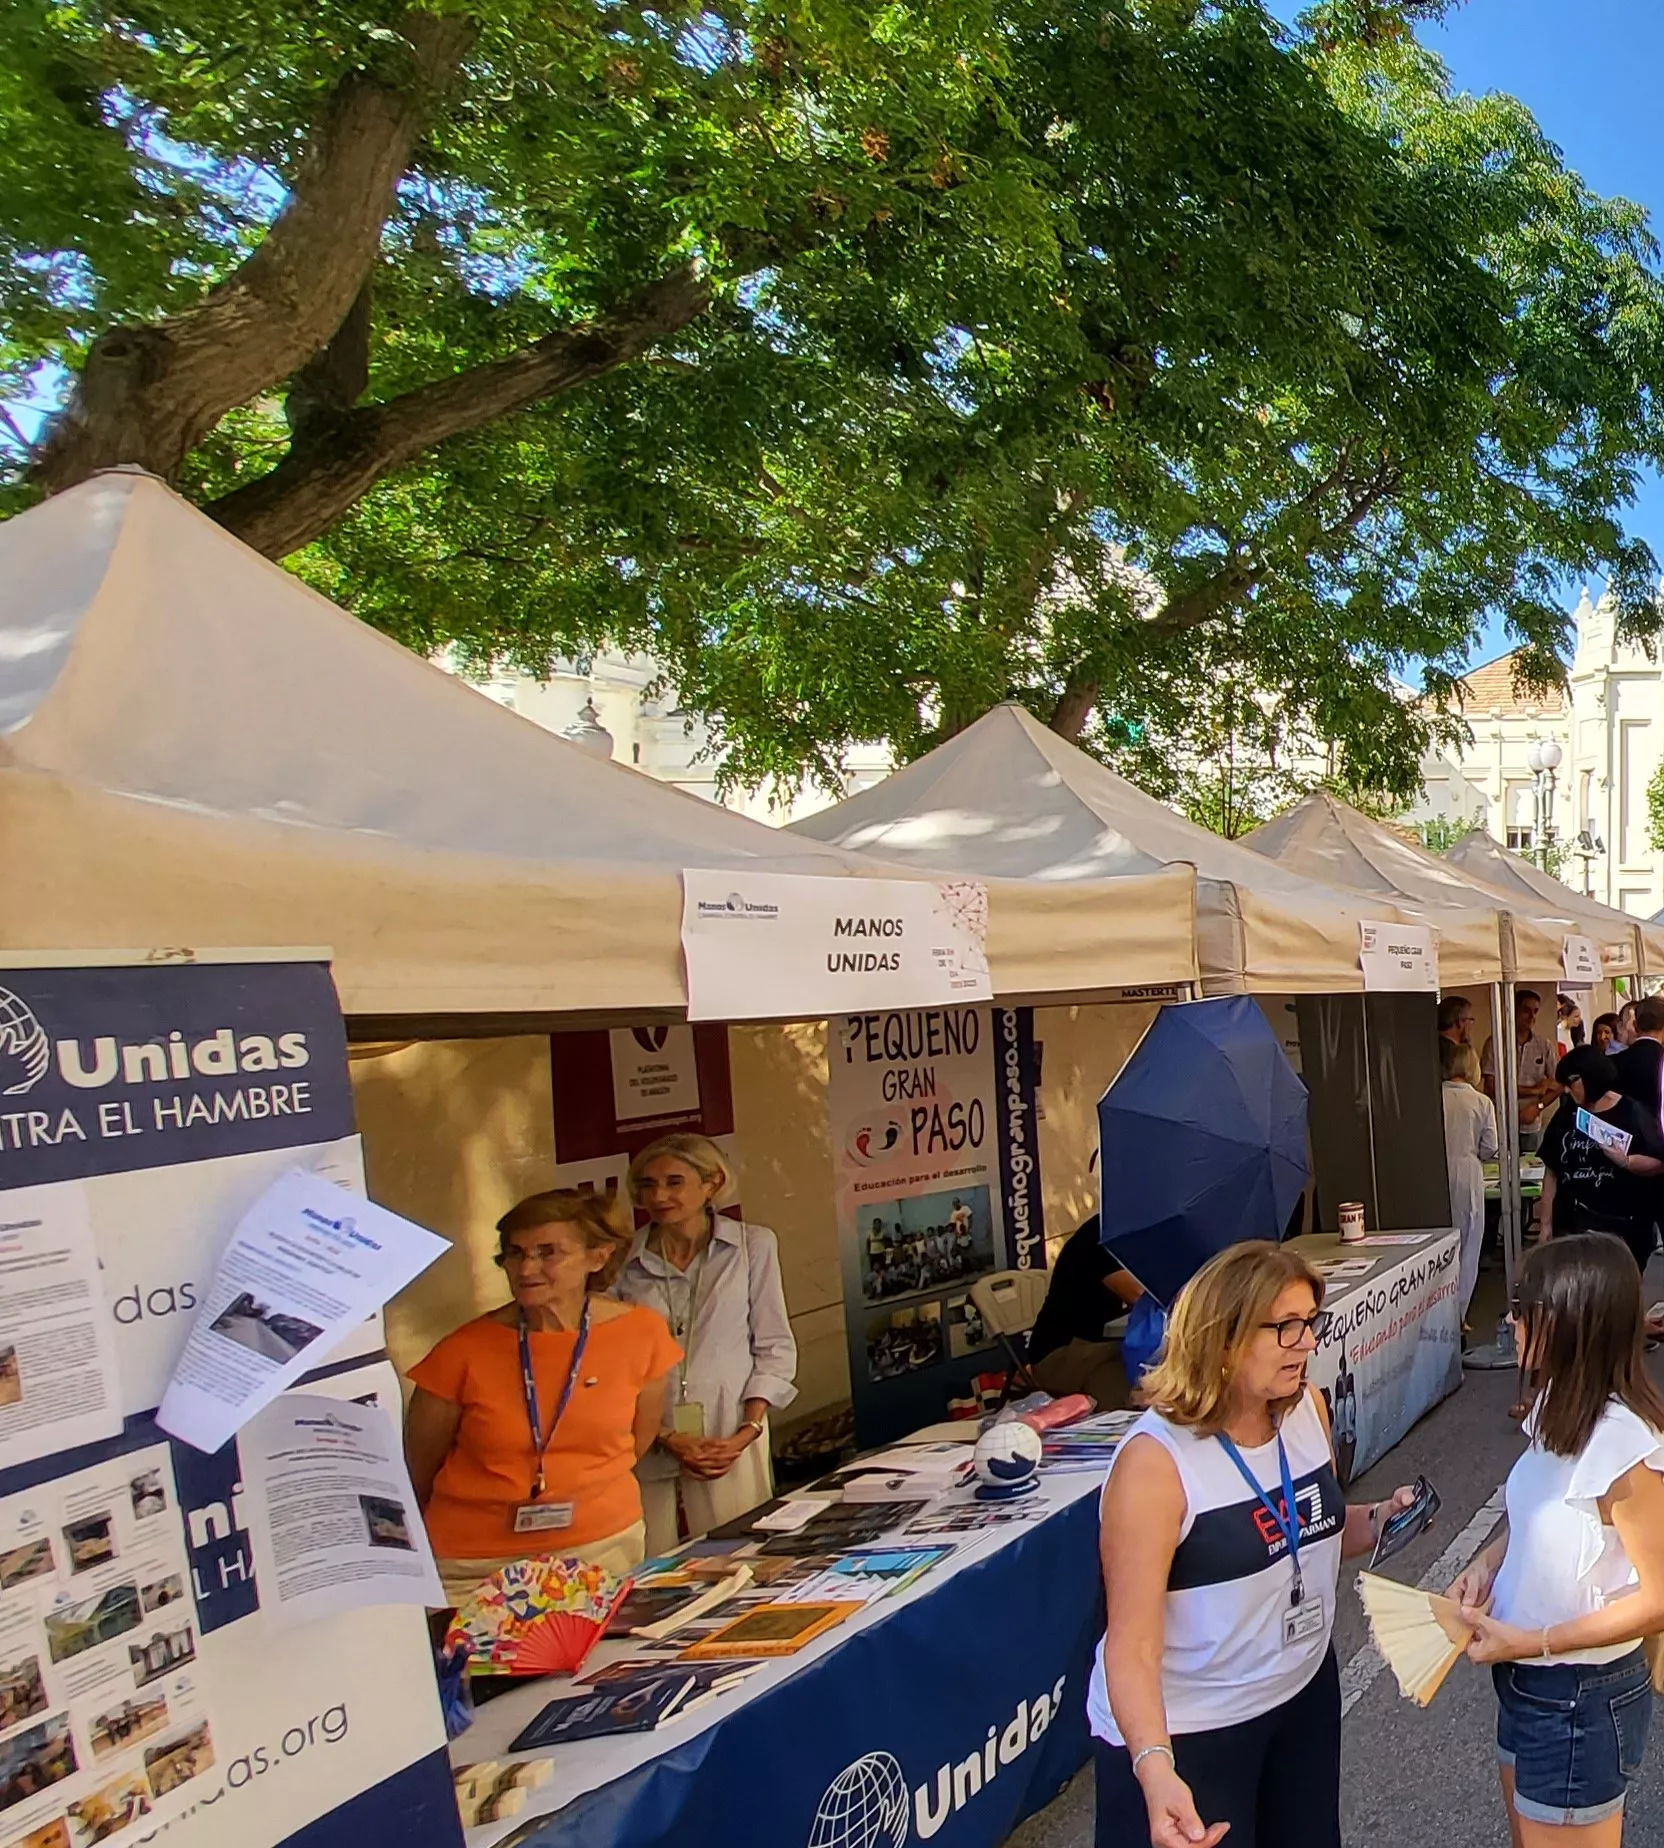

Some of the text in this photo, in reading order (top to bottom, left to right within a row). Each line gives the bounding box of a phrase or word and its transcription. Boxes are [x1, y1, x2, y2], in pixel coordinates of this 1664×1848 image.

[834, 917, 904, 938] MANOS
[827, 953, 901, 974] UNIDAS
[55, 1027, 311, 1089] Unidas
[882, 1066, 936, 1102] GRAN
[0, 1082, 312, 1150] TRA EL HAMBRE
[911, 1098, 985, 1156] PASO
[854, 1164, 987, 1193] Educación para el desarrollo
[1389, 1264, 1426, 1308] GRAN
[1428, 1245, 1457, 1282] PASO
[914, 1674, 1067, 1840] Unidas
